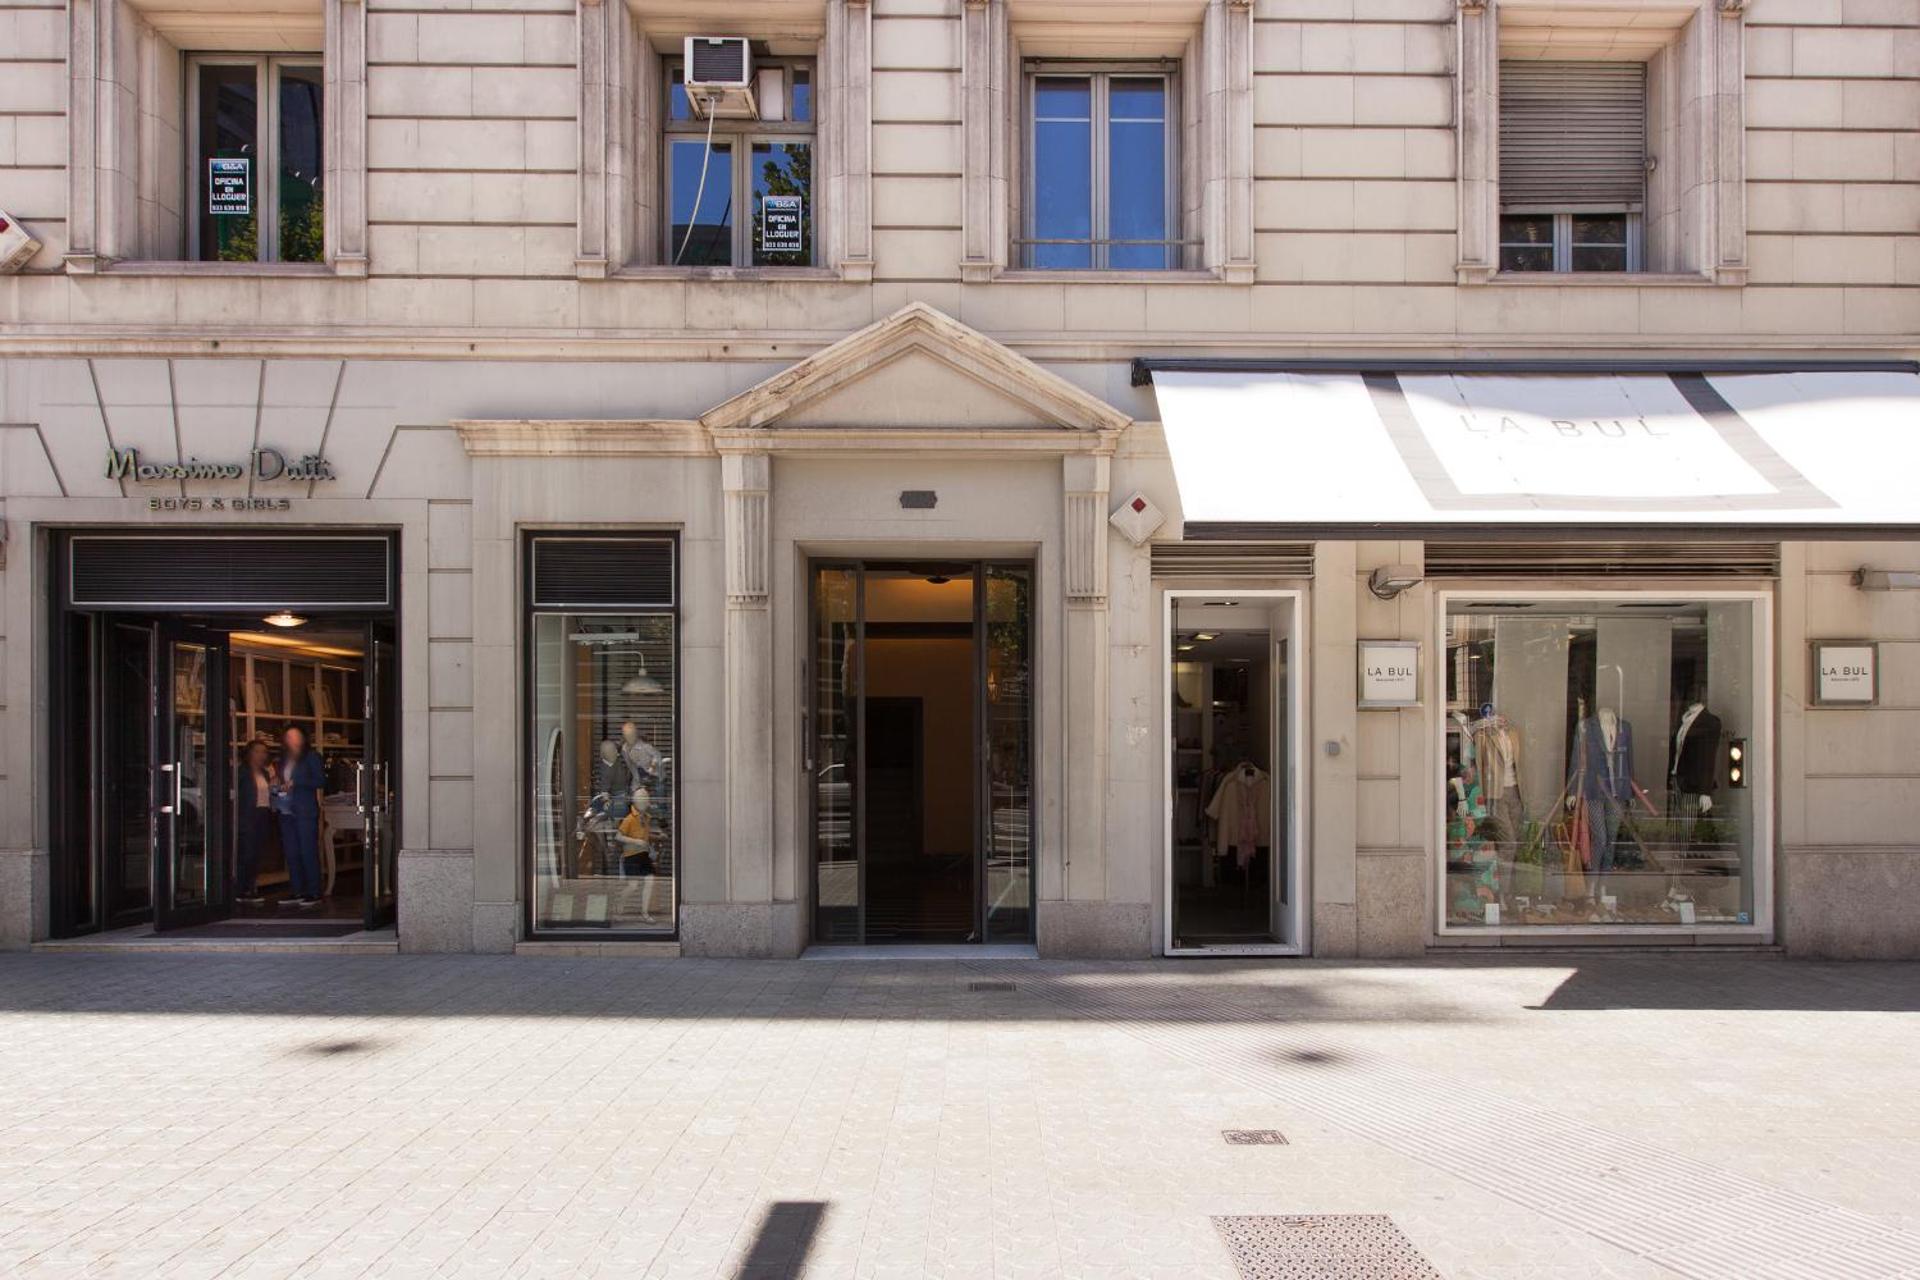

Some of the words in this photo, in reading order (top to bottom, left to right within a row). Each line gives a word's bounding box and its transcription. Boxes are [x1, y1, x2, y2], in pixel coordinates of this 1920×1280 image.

[214, 177, 244, 185] OFICINA
[211, 193, 247, 201] LLOGUER
[767, 214, 797, 223] OFICINA
[766, 230, 800, 238] LLOGUER
[1460, 414, 1530, 434] LA
[1551, 418, 1670, 438] BUL
[103, 447, 242, 482] Massimo
[252, 447, 336, 482] Dutti
[149, 496, 202, 511] BOYS
[211, 496, 225, 511] &
[231, 497, 291, 511] GIRLS
[1367, 667, 1382, 676] LA
[1388, 667, 1413, 676] BUL
[1822, 667, 1837, 675] LA
[1842, 666, 1868, 676] BUL
